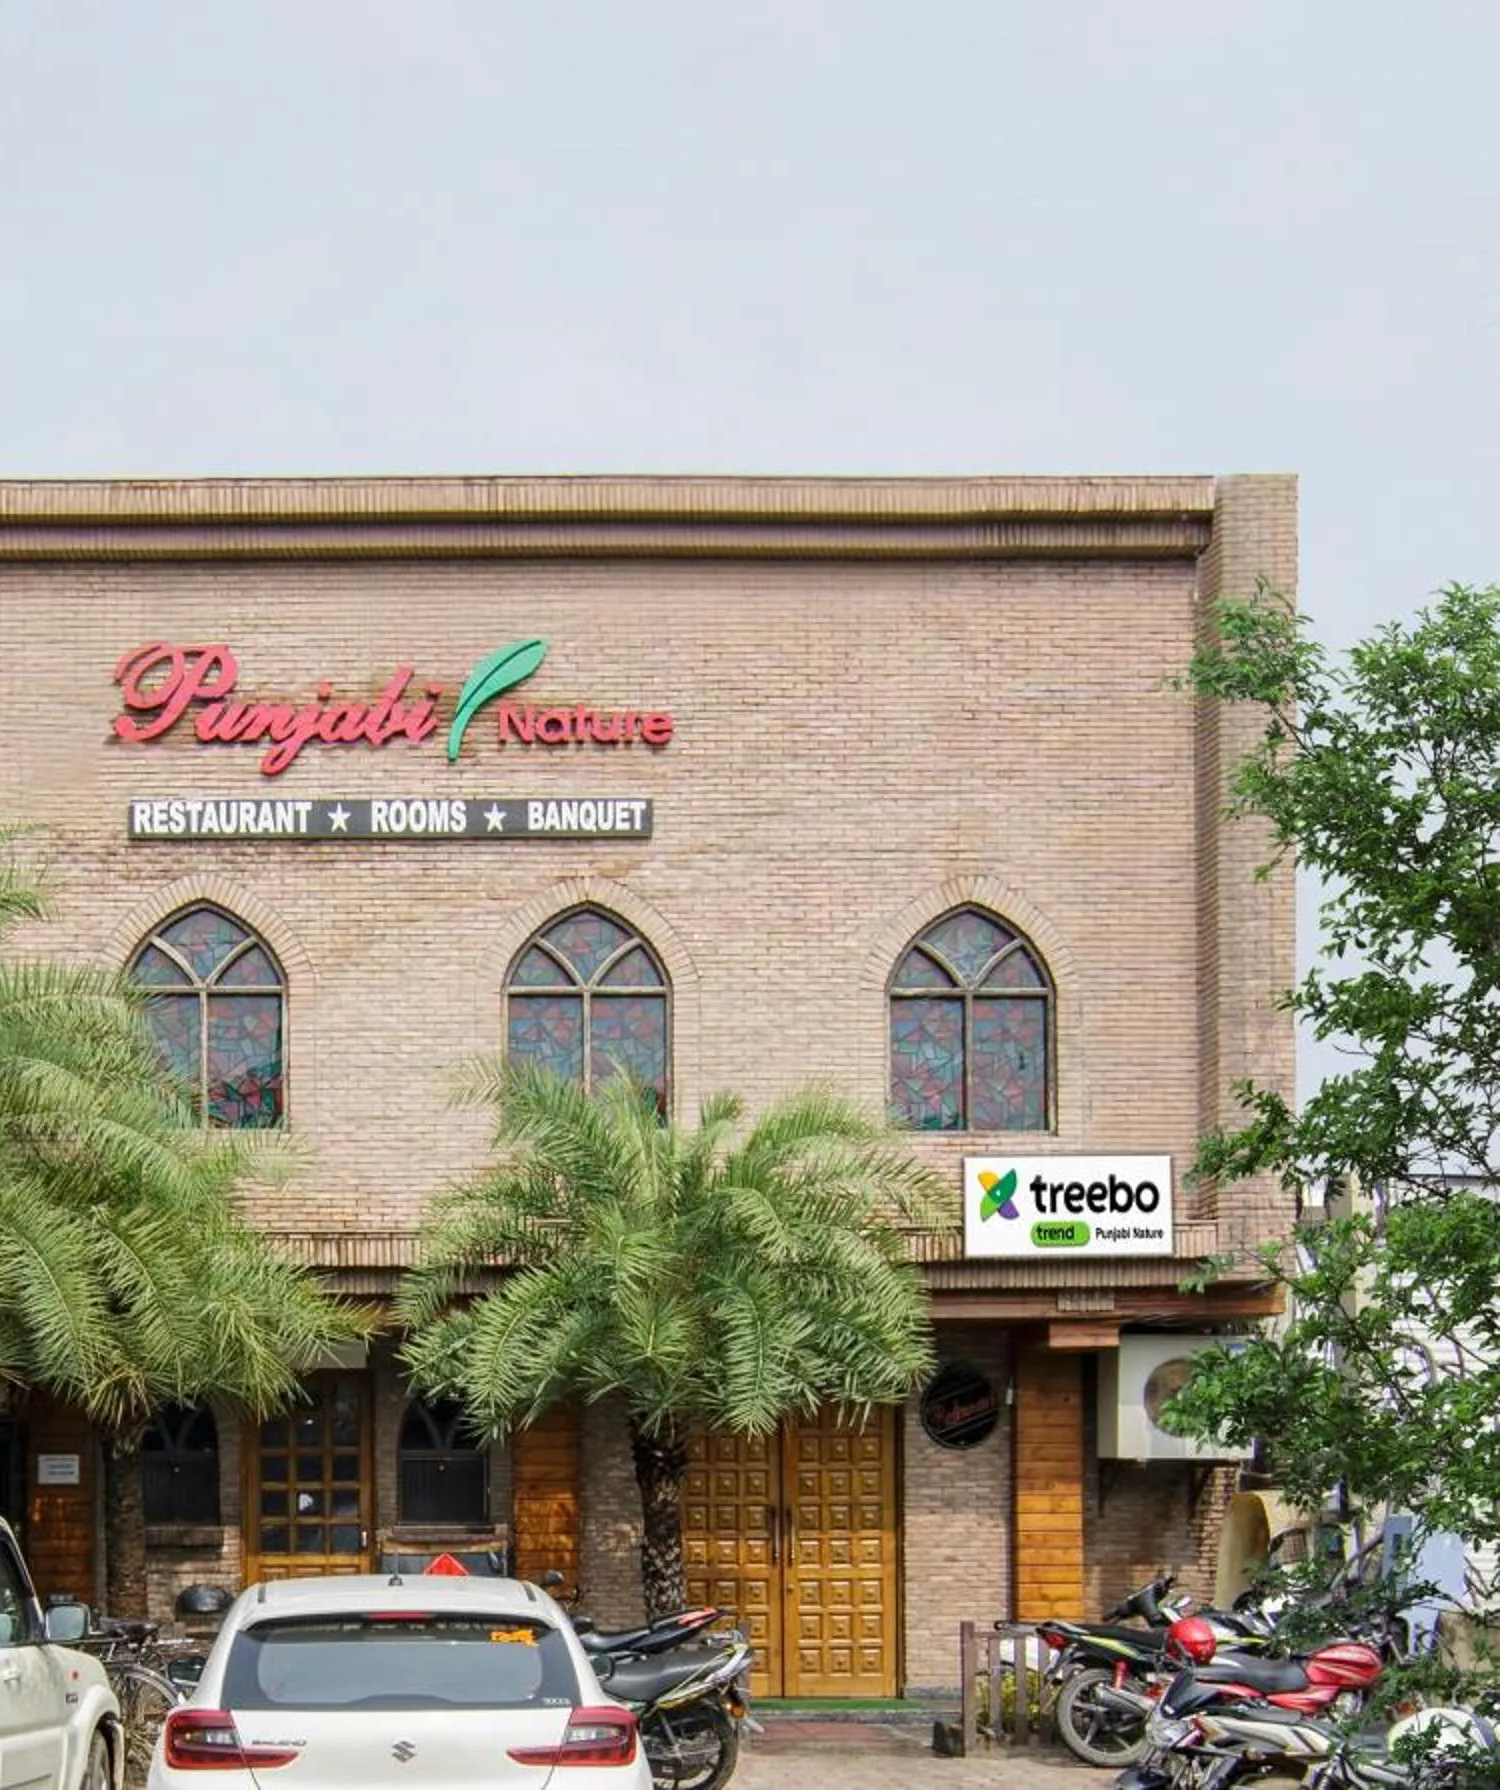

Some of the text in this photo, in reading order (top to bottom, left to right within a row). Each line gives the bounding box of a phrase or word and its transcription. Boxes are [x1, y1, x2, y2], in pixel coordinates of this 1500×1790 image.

[112, 642, 674, 776] Punjabi Nature
[132, 800, 646, 834] RESTAURANT ROOMS BANQUET
[1029, 1174, 1160, 1214] treebo
[1035, 1225, 1075, 1241] trend
[1095, 1226, 1165, 1243] Punjabi Nature
